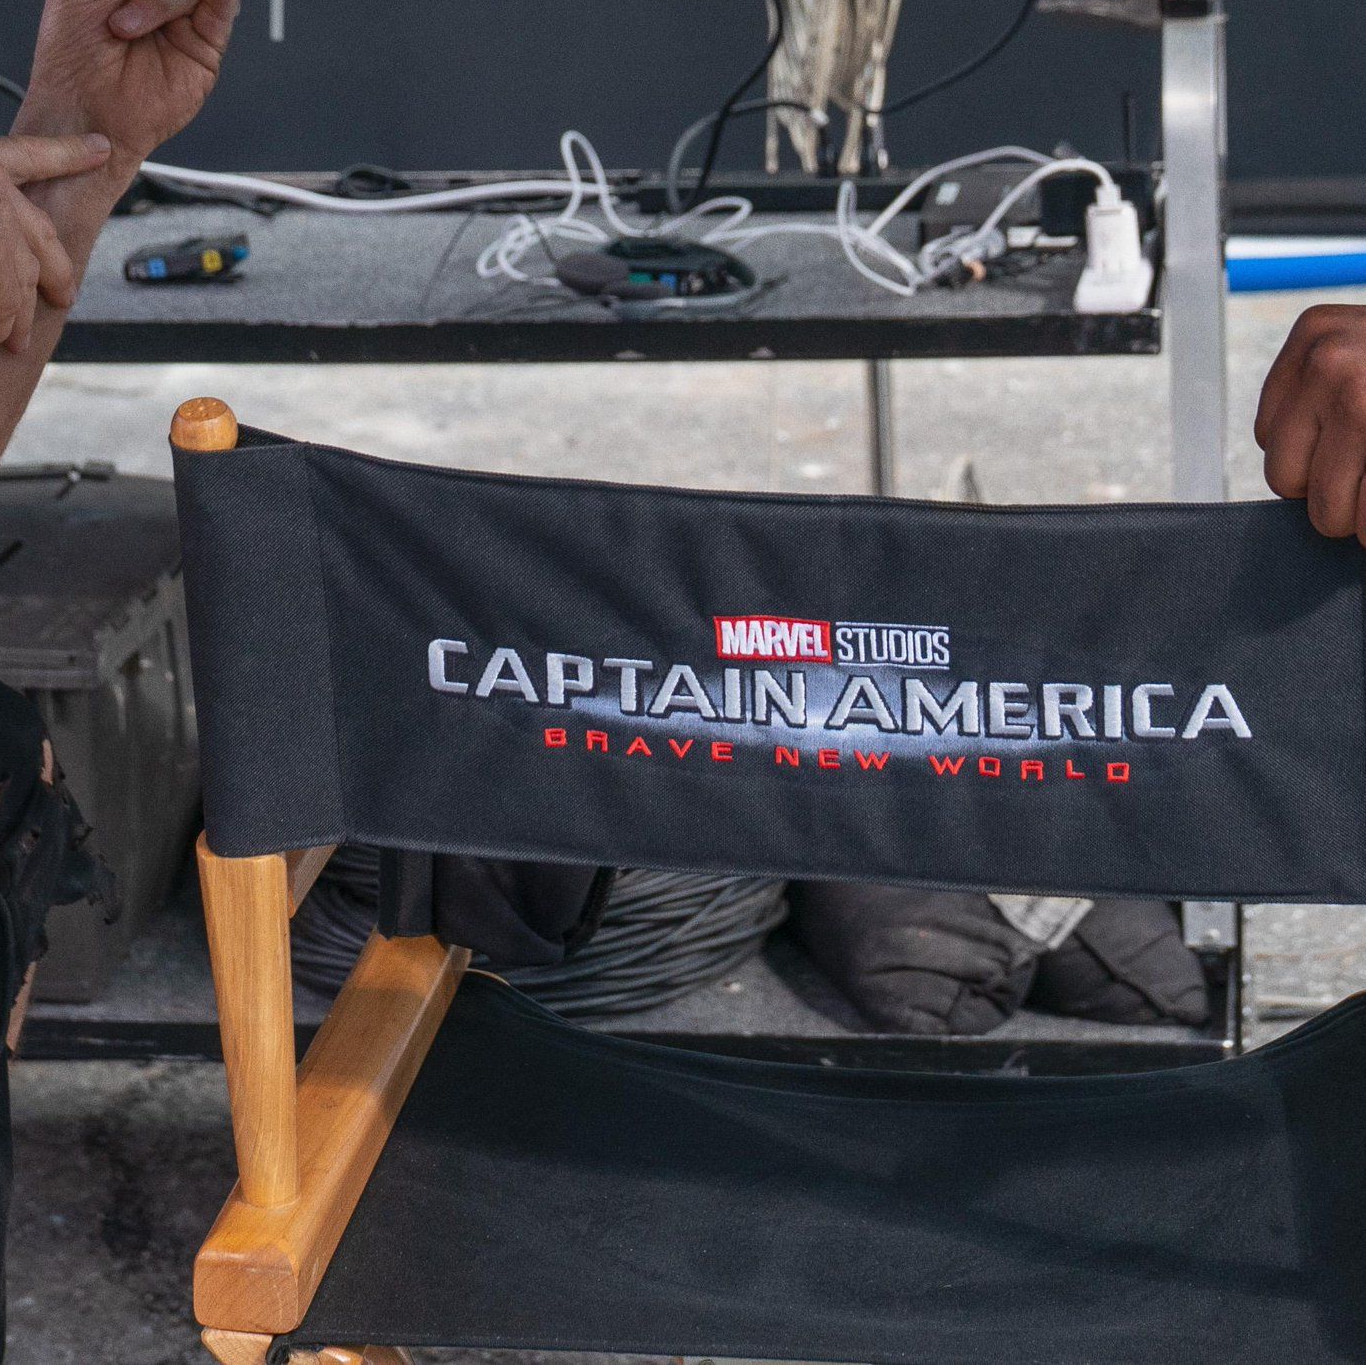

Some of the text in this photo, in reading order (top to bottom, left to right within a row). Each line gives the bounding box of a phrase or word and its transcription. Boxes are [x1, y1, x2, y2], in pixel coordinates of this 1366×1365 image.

[721, 620, 951, 666] MARVEL STUDIOS
[427, 637, 1253, 739] CAPTAIN AMERICA
[543, 727, 1130, 784] BRAVE NEW WORLD
